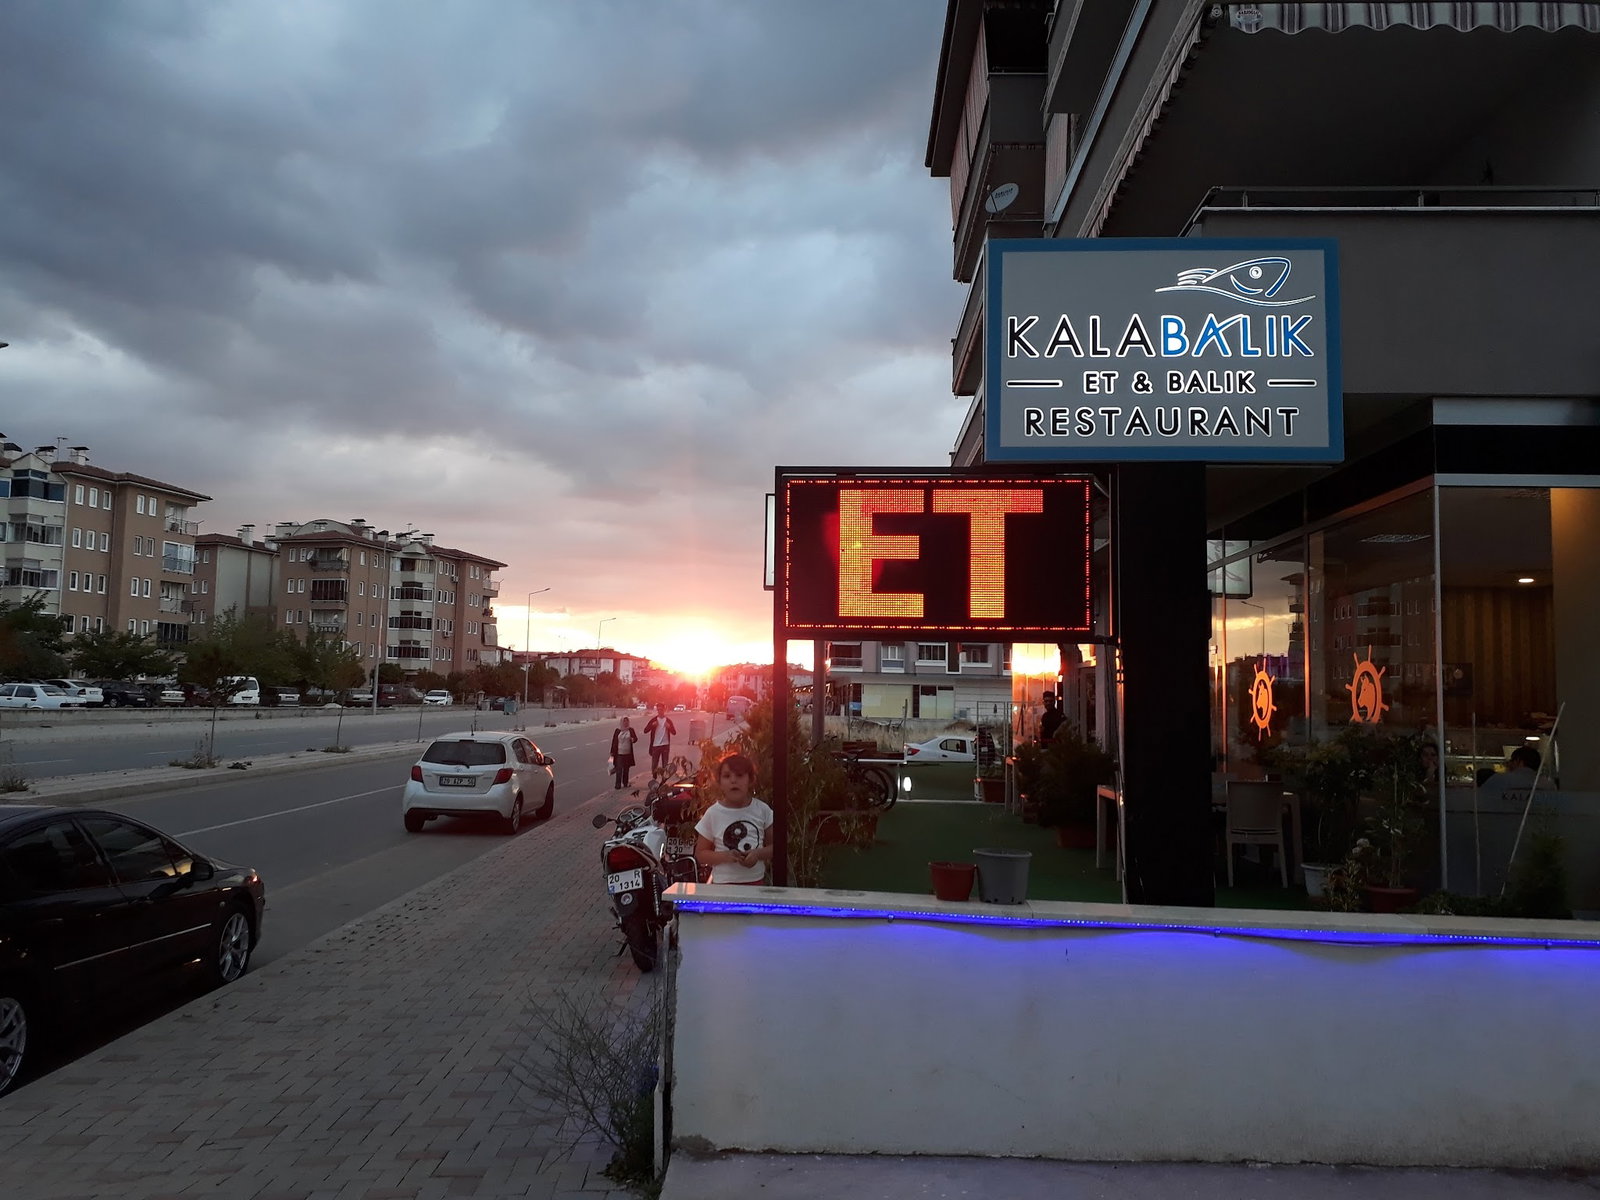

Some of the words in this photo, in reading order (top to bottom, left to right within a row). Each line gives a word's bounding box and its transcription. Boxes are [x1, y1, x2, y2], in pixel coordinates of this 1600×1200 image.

[1006, 313, 1315, 358] KALABALIK
[1083, 370, 1120, 394] ET
[1131, 370, 1154, 394] &
[1167, 370, 1256, 394] BALIK
[1024, 405, 1299, 437] RESTAURANT
[838, 489, 1044, 619] ET
[609, 874, 620, 884] 20
[633, 869, 641, 879] R
[620, 878, 641, 890] 1314
